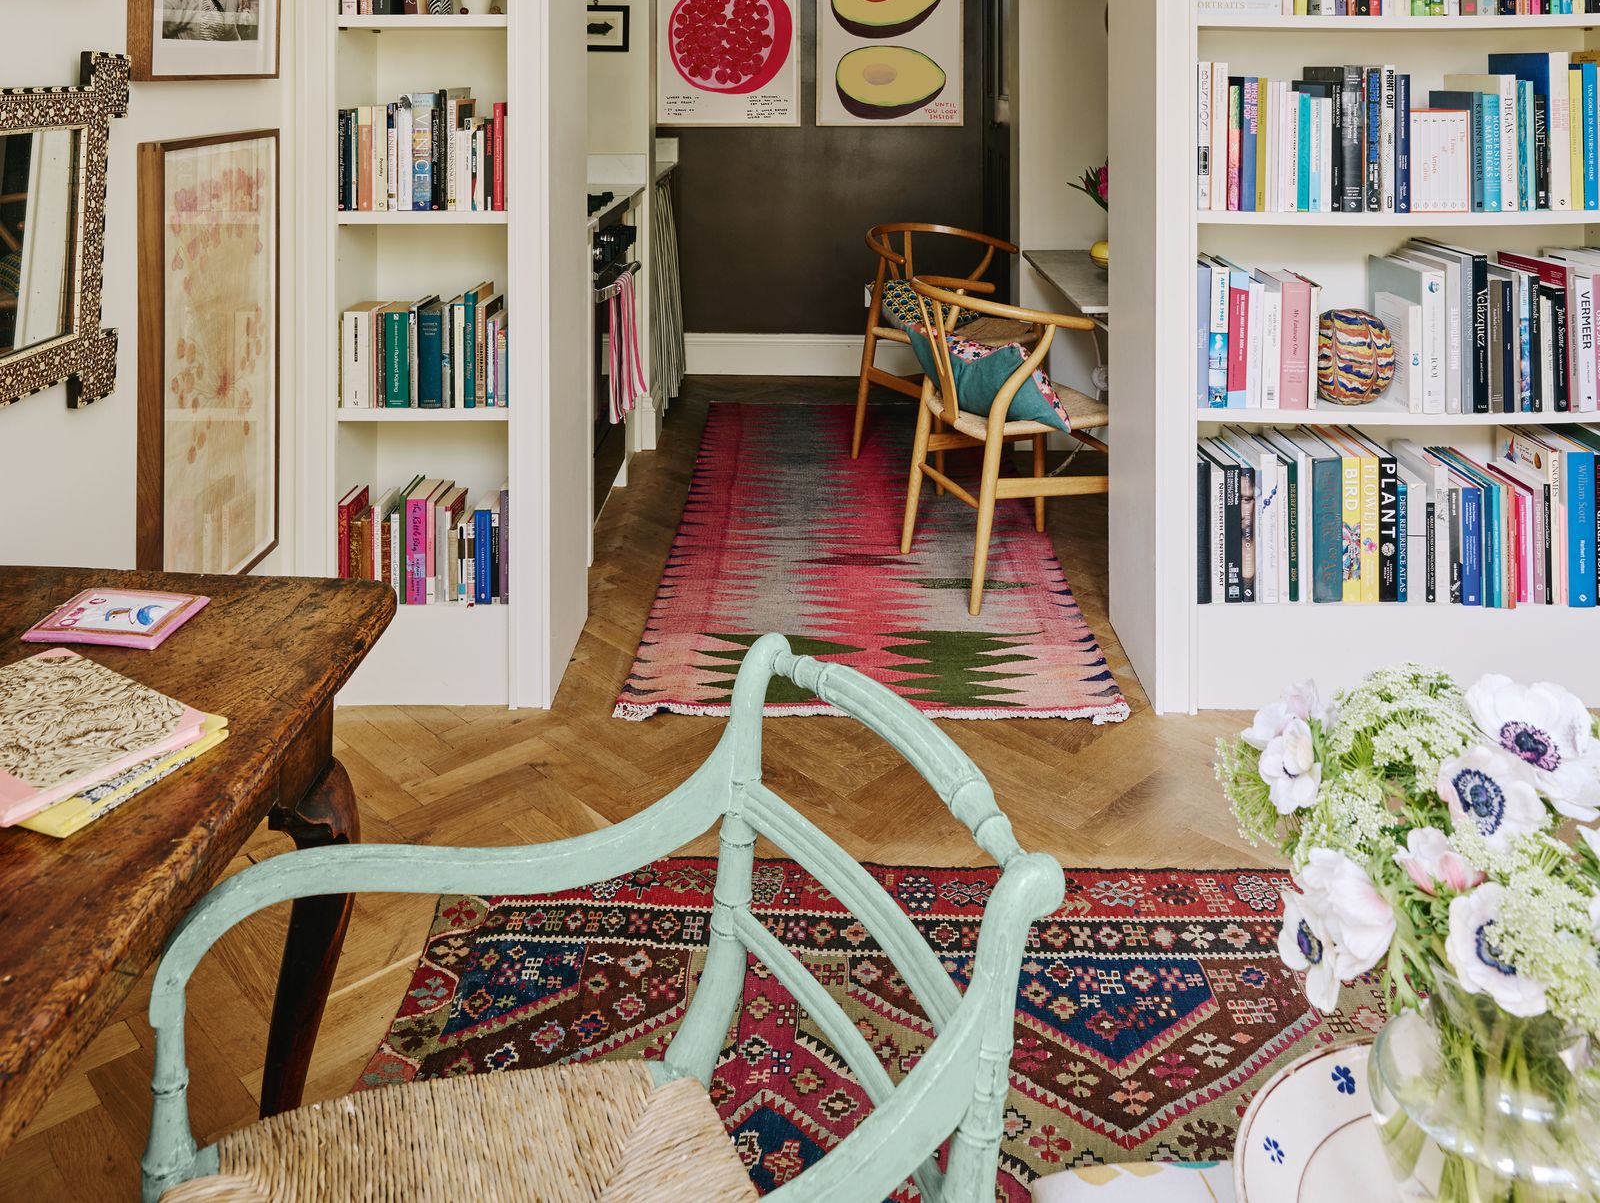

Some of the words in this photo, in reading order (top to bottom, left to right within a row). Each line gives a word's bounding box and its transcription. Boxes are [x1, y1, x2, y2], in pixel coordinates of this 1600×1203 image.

[1386, 69, 1394, 92] PRINT
[1386, 94, 1394, 110] OUT
[1485, 115, 1493, 123] &
[1504, 97, 1514, 134] DEGAS
[1536, 109, 1546, 148] MANET
[414, 113, 432, 184] VENICE
[1292, 309, 1299, 318] My
[1466, 309, 1472, 319] DA
[1474, 288, 1488, 348] Velázquez
[1555, 306, 1566, 325] John
[1580, 290, 1592, 350] VERMEER
[1558, 326, 1566, 348] Soane
[1344, 468, 1359, 512] BIRD
[1577, 464, 1588, 500] William
[412, 503, 421, 513] The
[1363, 464, 1377, 533] FLOWER
[1381, 462, 1396, 539] PLANT
[1577, 501, 1588, 524] Scott
[412, 516, 422, 536] Rattle
[411, 537, 421, 552] Bag
